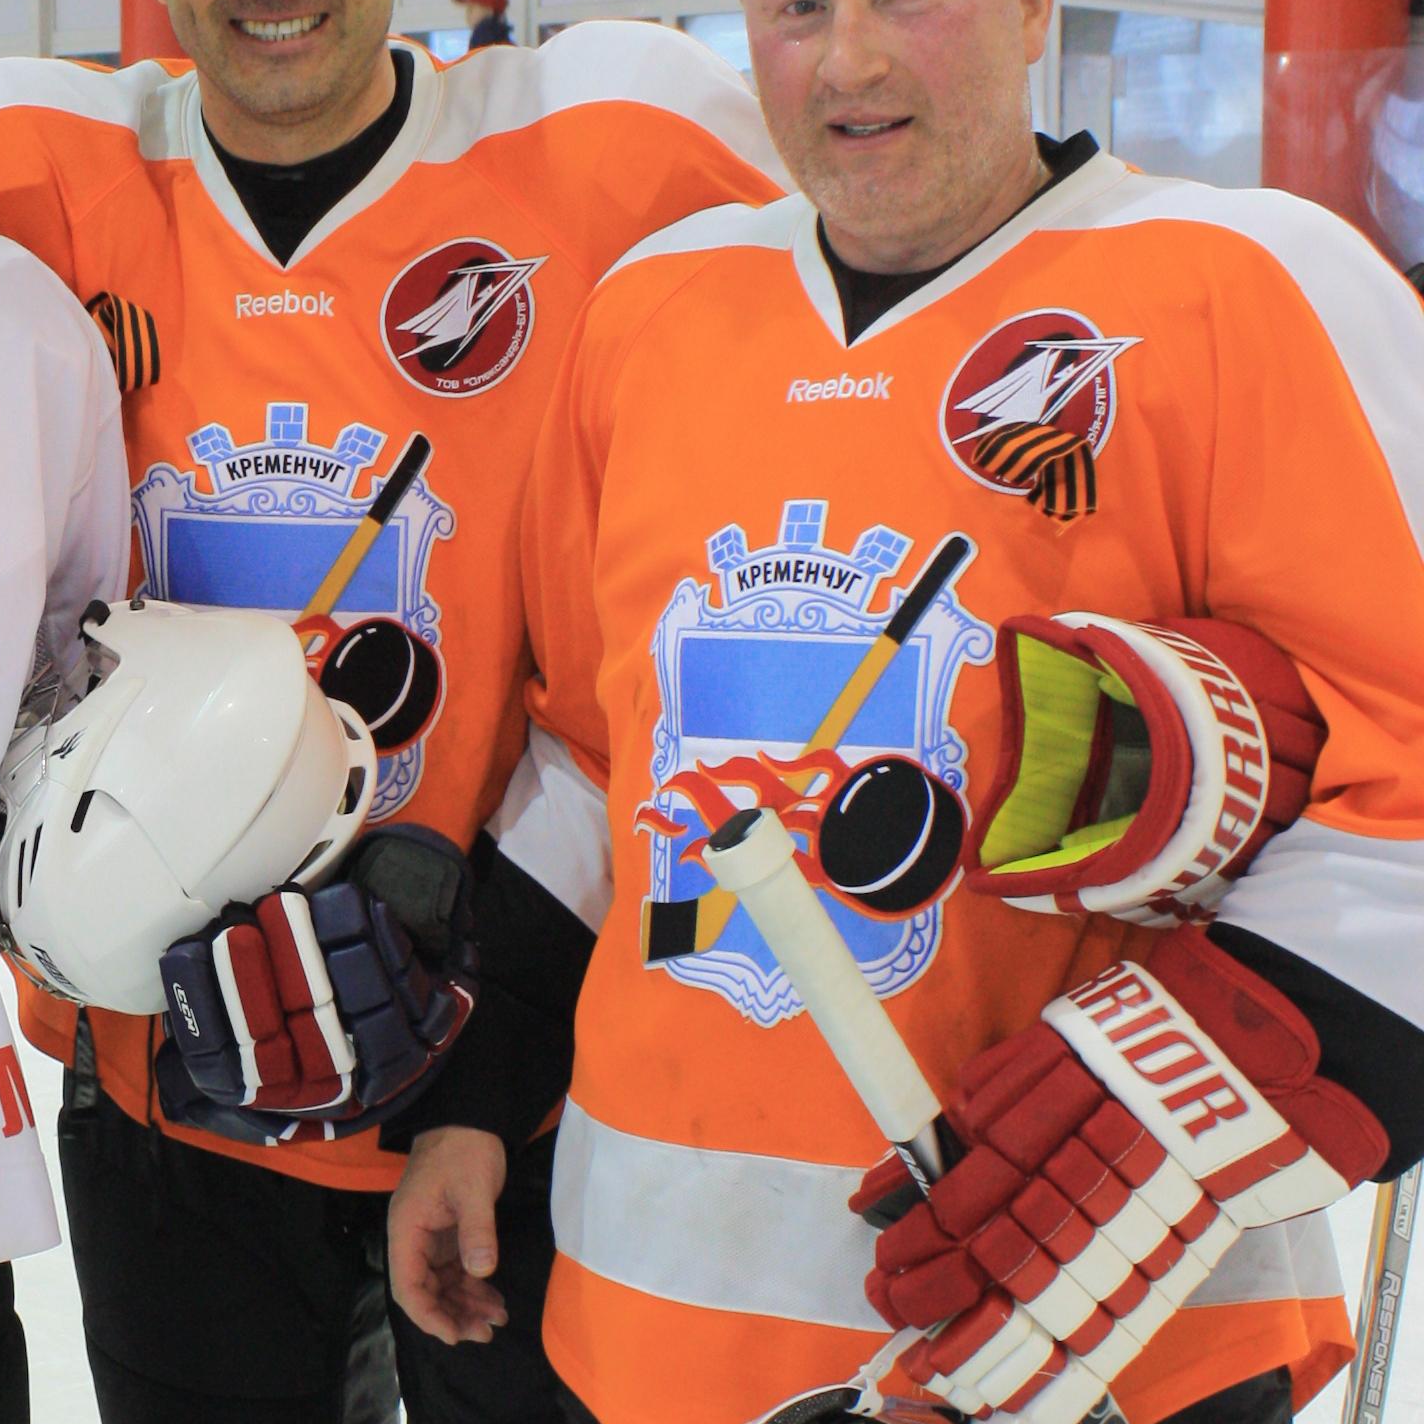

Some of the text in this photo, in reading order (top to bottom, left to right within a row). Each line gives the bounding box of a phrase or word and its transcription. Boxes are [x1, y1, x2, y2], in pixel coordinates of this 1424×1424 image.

[236, 289, 335, 319] Reebok
[436, 377, 460, 389] ТОВ
[786, 372, 894, 403] Reebok
[226, 454, 346, 483] КРЕМЕНЧУГ
[736, 560, 863, 595] КРЕМЕНЧУГ
[176, 986, 199, 1035] CCM
[1367, 1271, 1403, 1408] RESPONSE
